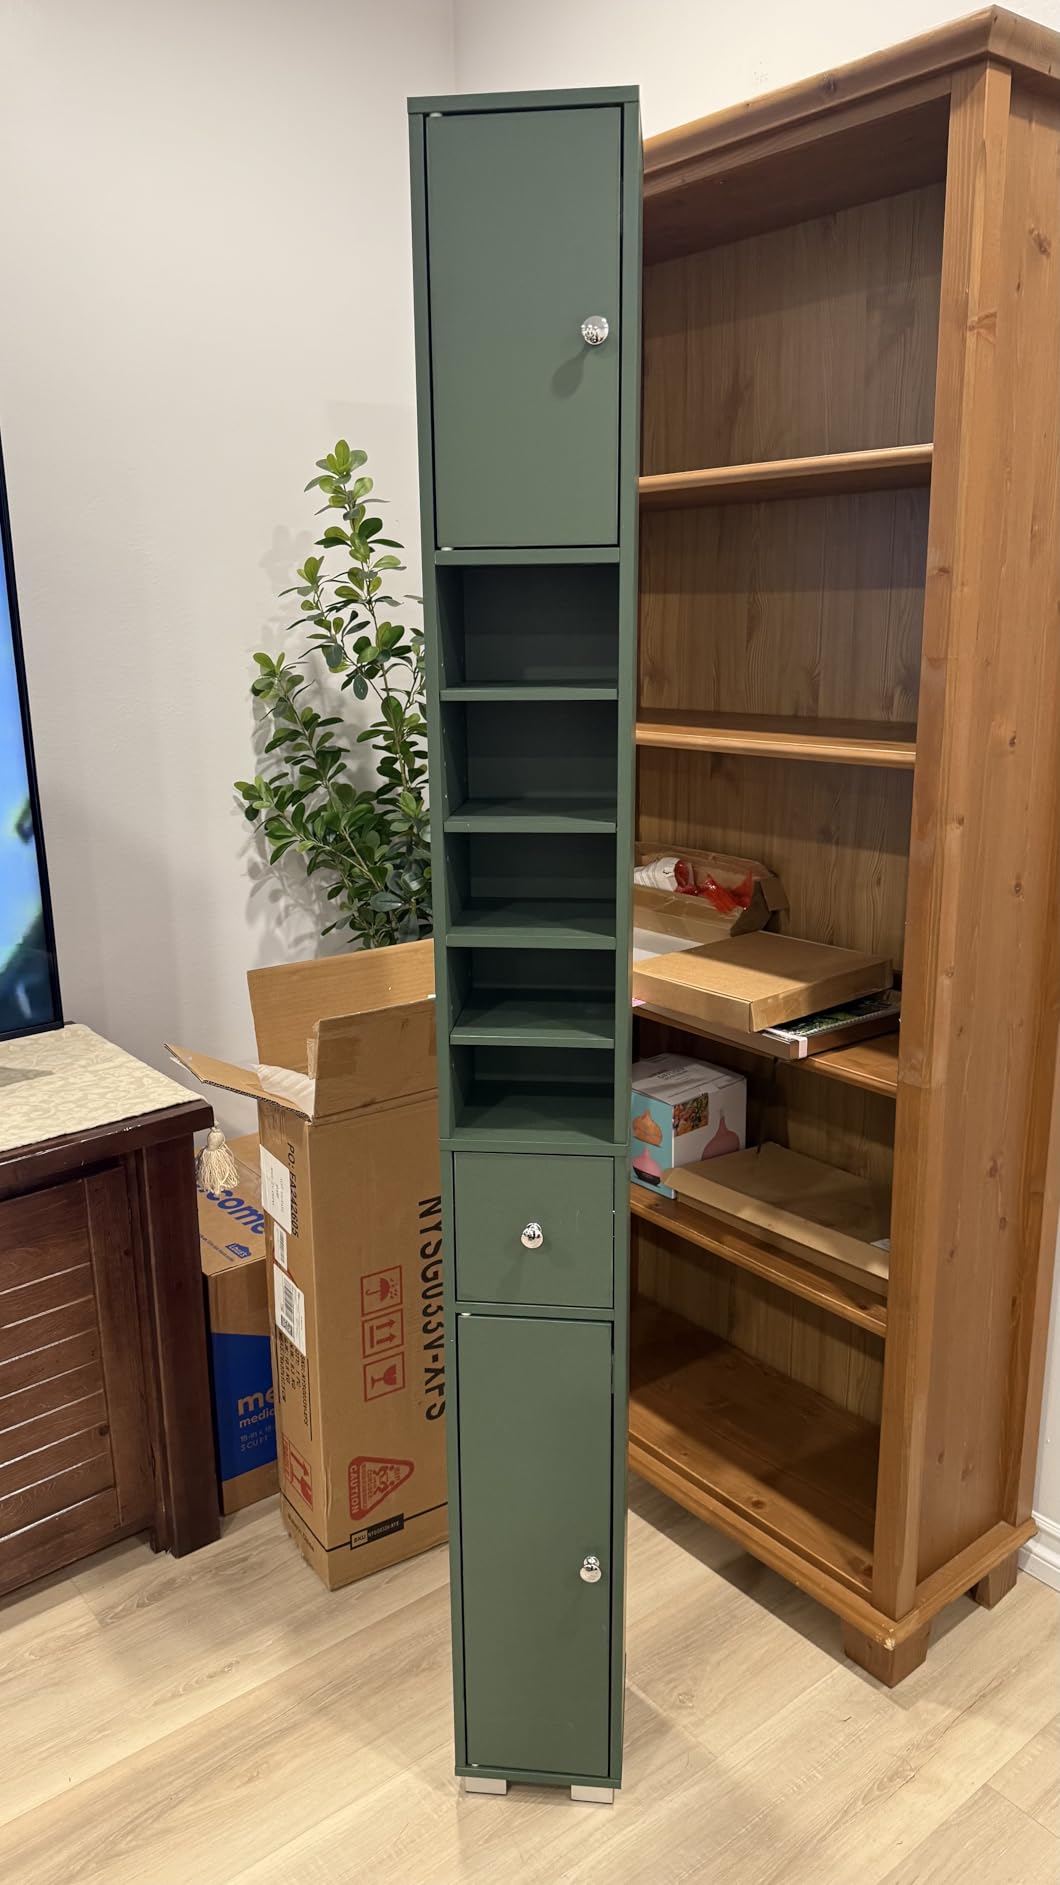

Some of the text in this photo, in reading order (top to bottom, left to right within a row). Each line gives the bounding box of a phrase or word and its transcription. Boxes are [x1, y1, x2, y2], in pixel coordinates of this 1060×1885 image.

[287, 1142, 295, 1169] PO:
[237, 1386, 275, 1416] me
[350, 1464, 360, 1514] CAUTION
